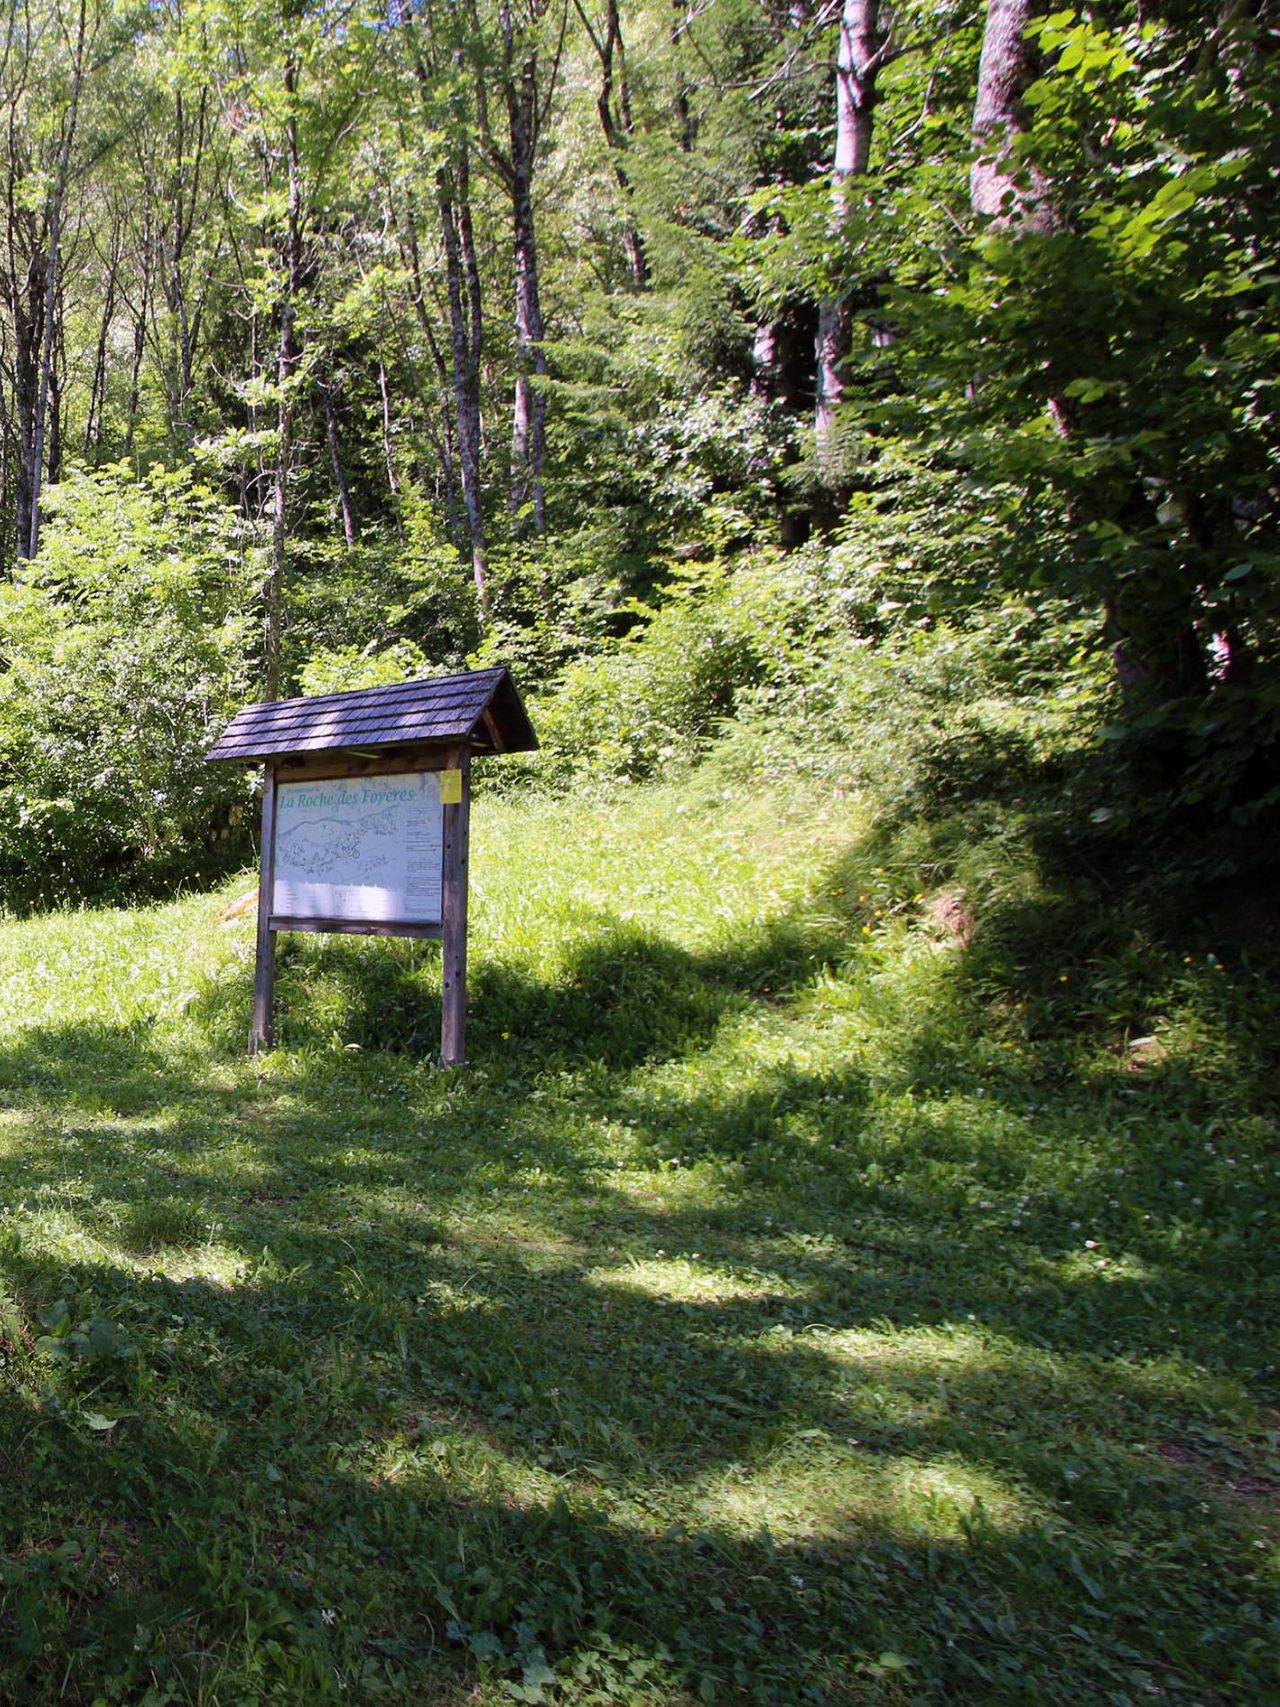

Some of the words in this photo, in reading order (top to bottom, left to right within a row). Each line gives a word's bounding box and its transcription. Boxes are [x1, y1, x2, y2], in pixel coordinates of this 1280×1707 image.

[280, 796, 294, 809] La
[298, 792, 333, 807] Roche
[337, 790, 358, 806] des
